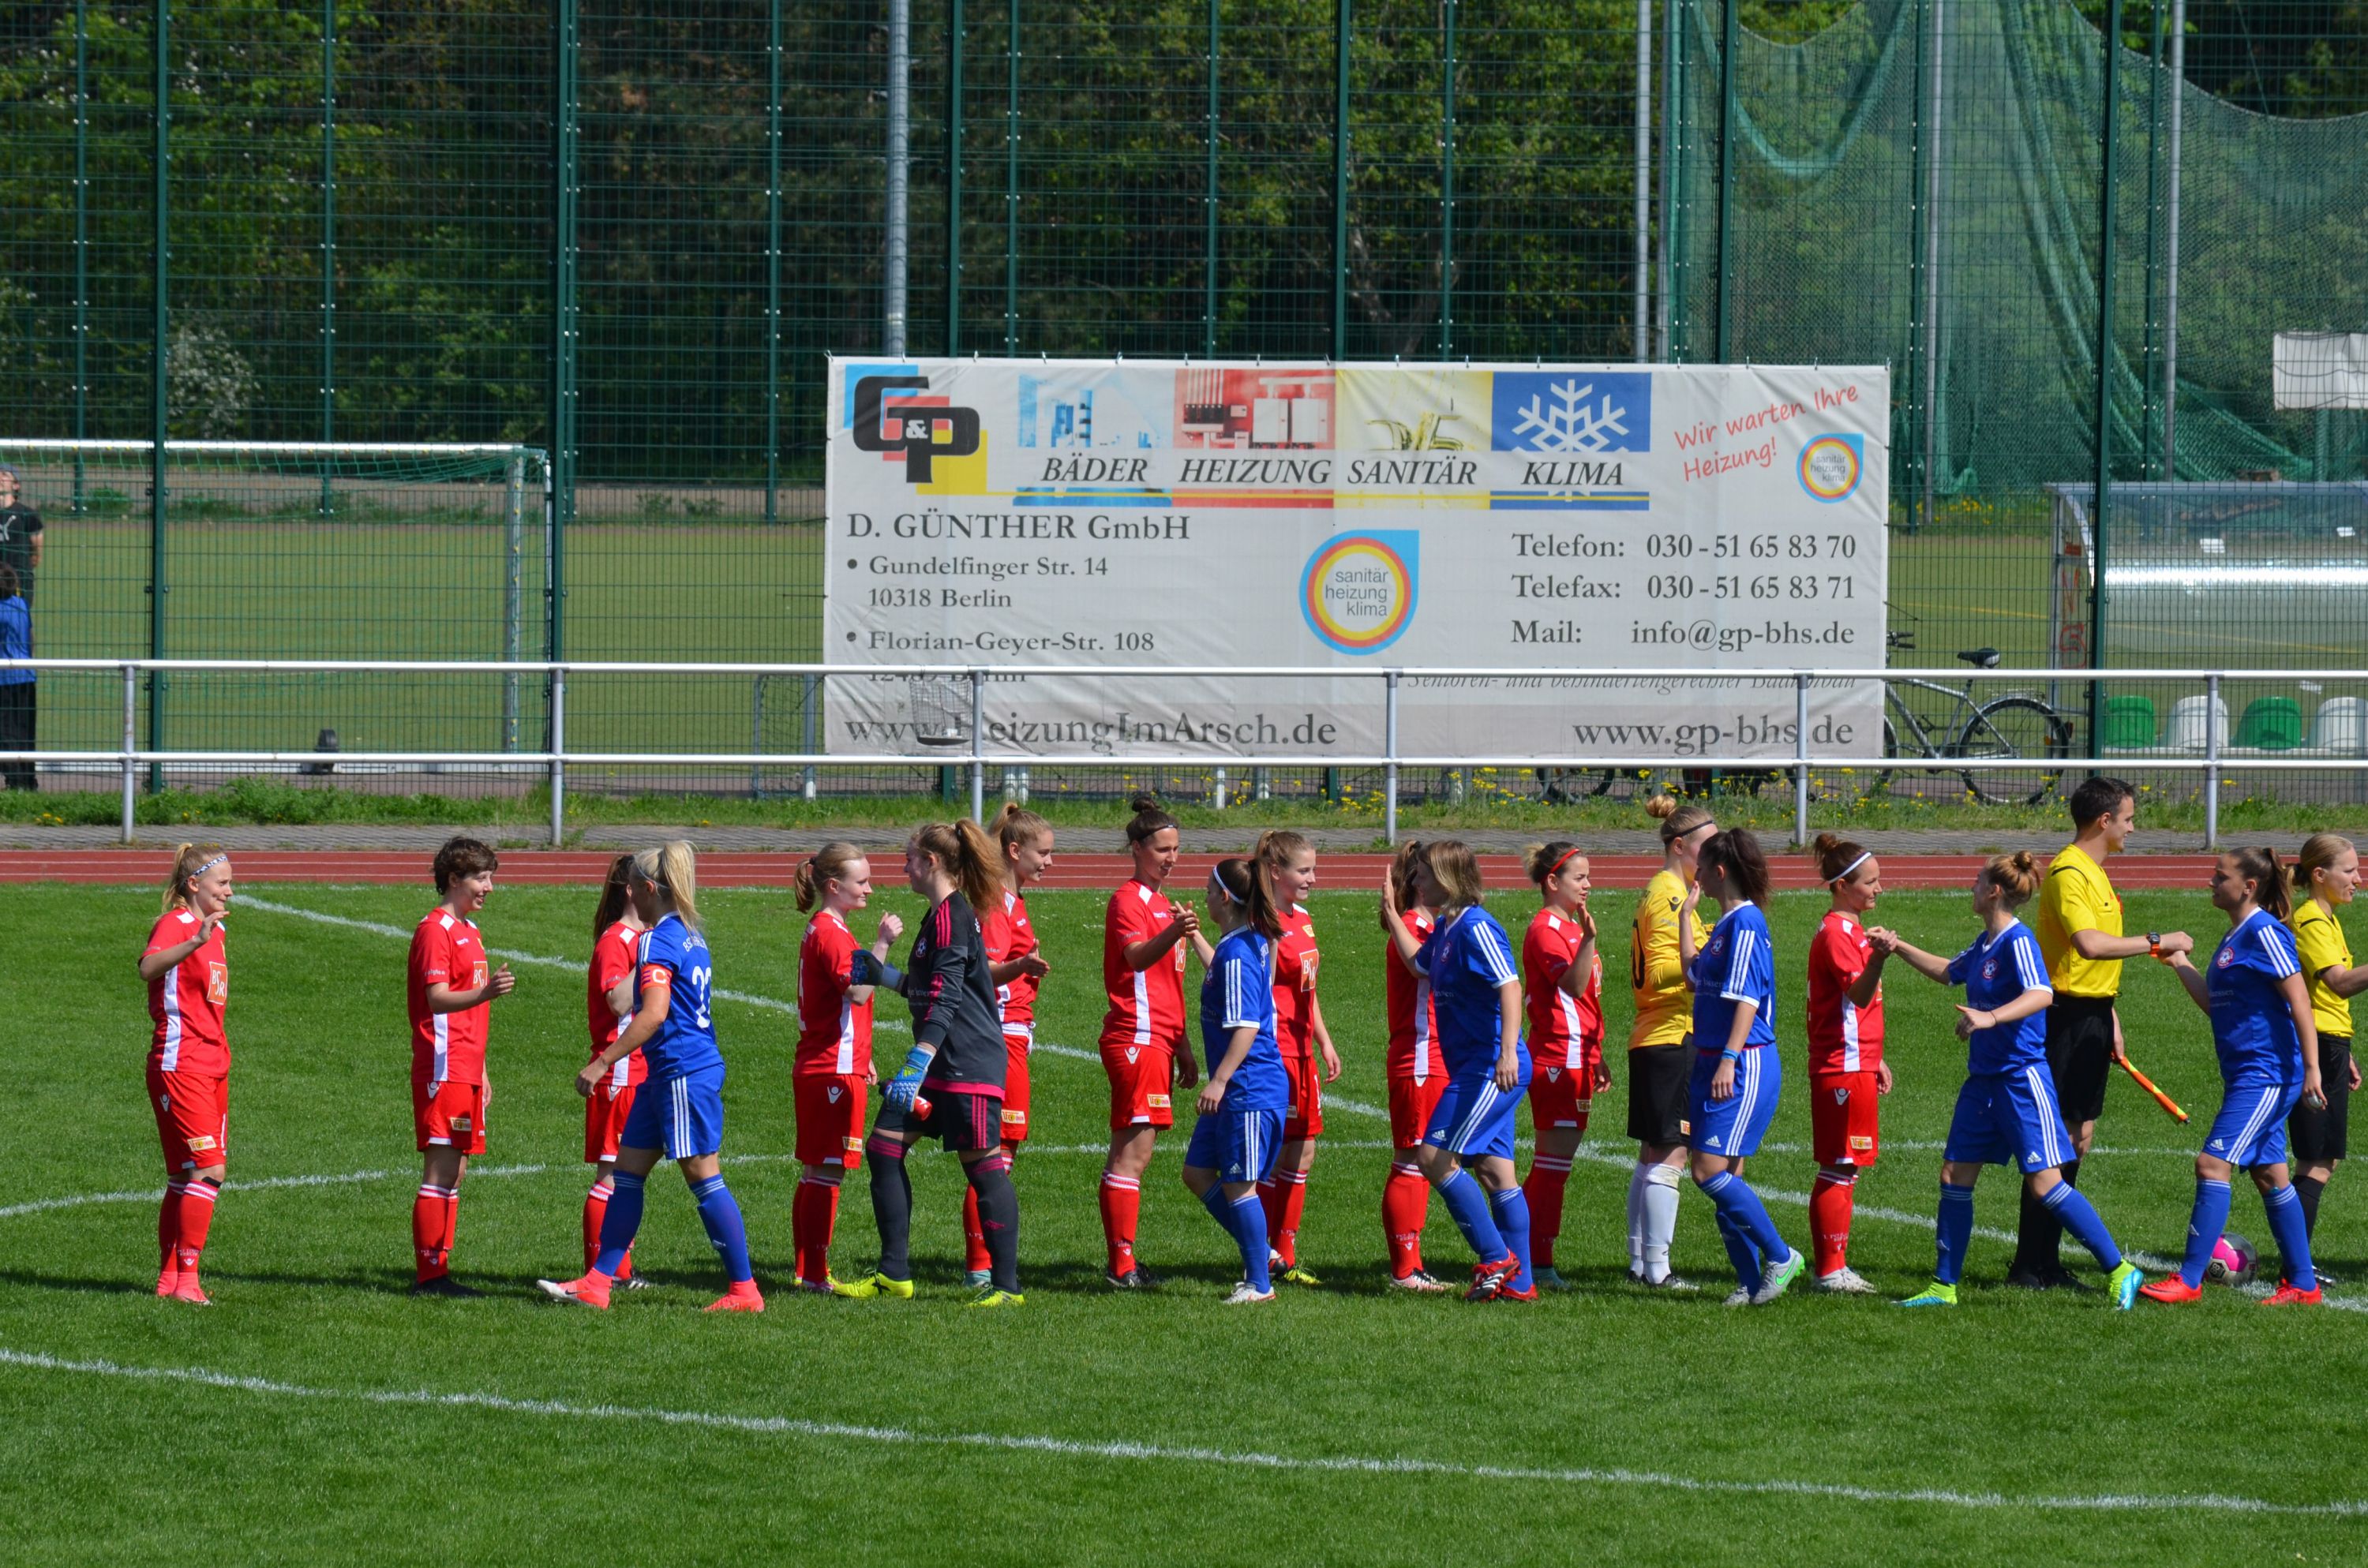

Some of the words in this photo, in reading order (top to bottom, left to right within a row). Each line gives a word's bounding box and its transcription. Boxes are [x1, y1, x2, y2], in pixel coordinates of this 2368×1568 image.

[1674, 421, 1718, 450] Wir
[1725, 402, 1807, 436] warten
[1814, 385, 1859, 411] Ihre
[1041, 452, 1148, 482] BÄDER
[1178, 458, 1332, 485] HEIZUNG
[1347, 455, 1478, 485] SANITÄR
[1521, 462, 1623, 486] KLIMA
[1683, 436, 1778, 482] Heizung!
[846, 513, 881, 538] D.
[894, 507, 1077, 539] GÜNTHER
[1088, 515, 1190, 540] GmbH
[1511, 533, 1624, 558] Telefon:
[1749, 534, 1779, 559] 65
[1788, 534, 1818, 559] 83
[1827, 534, 1857, 559] 70
[869, 555, 1029, 582] Gundelfinger
[1036, 556, 1076, 575] Str.
[1085, 556, 1109, 576] 14
[1336, 568, 1388, 583] sanitär
[869, 588, 931, 608] 10318
[940, 589, 1012, 608] Berlin
[1325, 585, 1388, 603] heizung
[1511, 574, 1621, 599] Telefax:
[1750, 575, 1780, 599] 65
[1789, 575, 1819, 599] 83
[1827, 575, 1854, 600] 71
[1347, 601, 1388, 616] klima
[868, 630, 1104, 657] Florian-Geyer-Str.
[1115, 632, 1155, 651] 108
[1511, 619, 1582, 644] Mail:
[1631, 619, 1855, 653] info@gp-bhs.de
